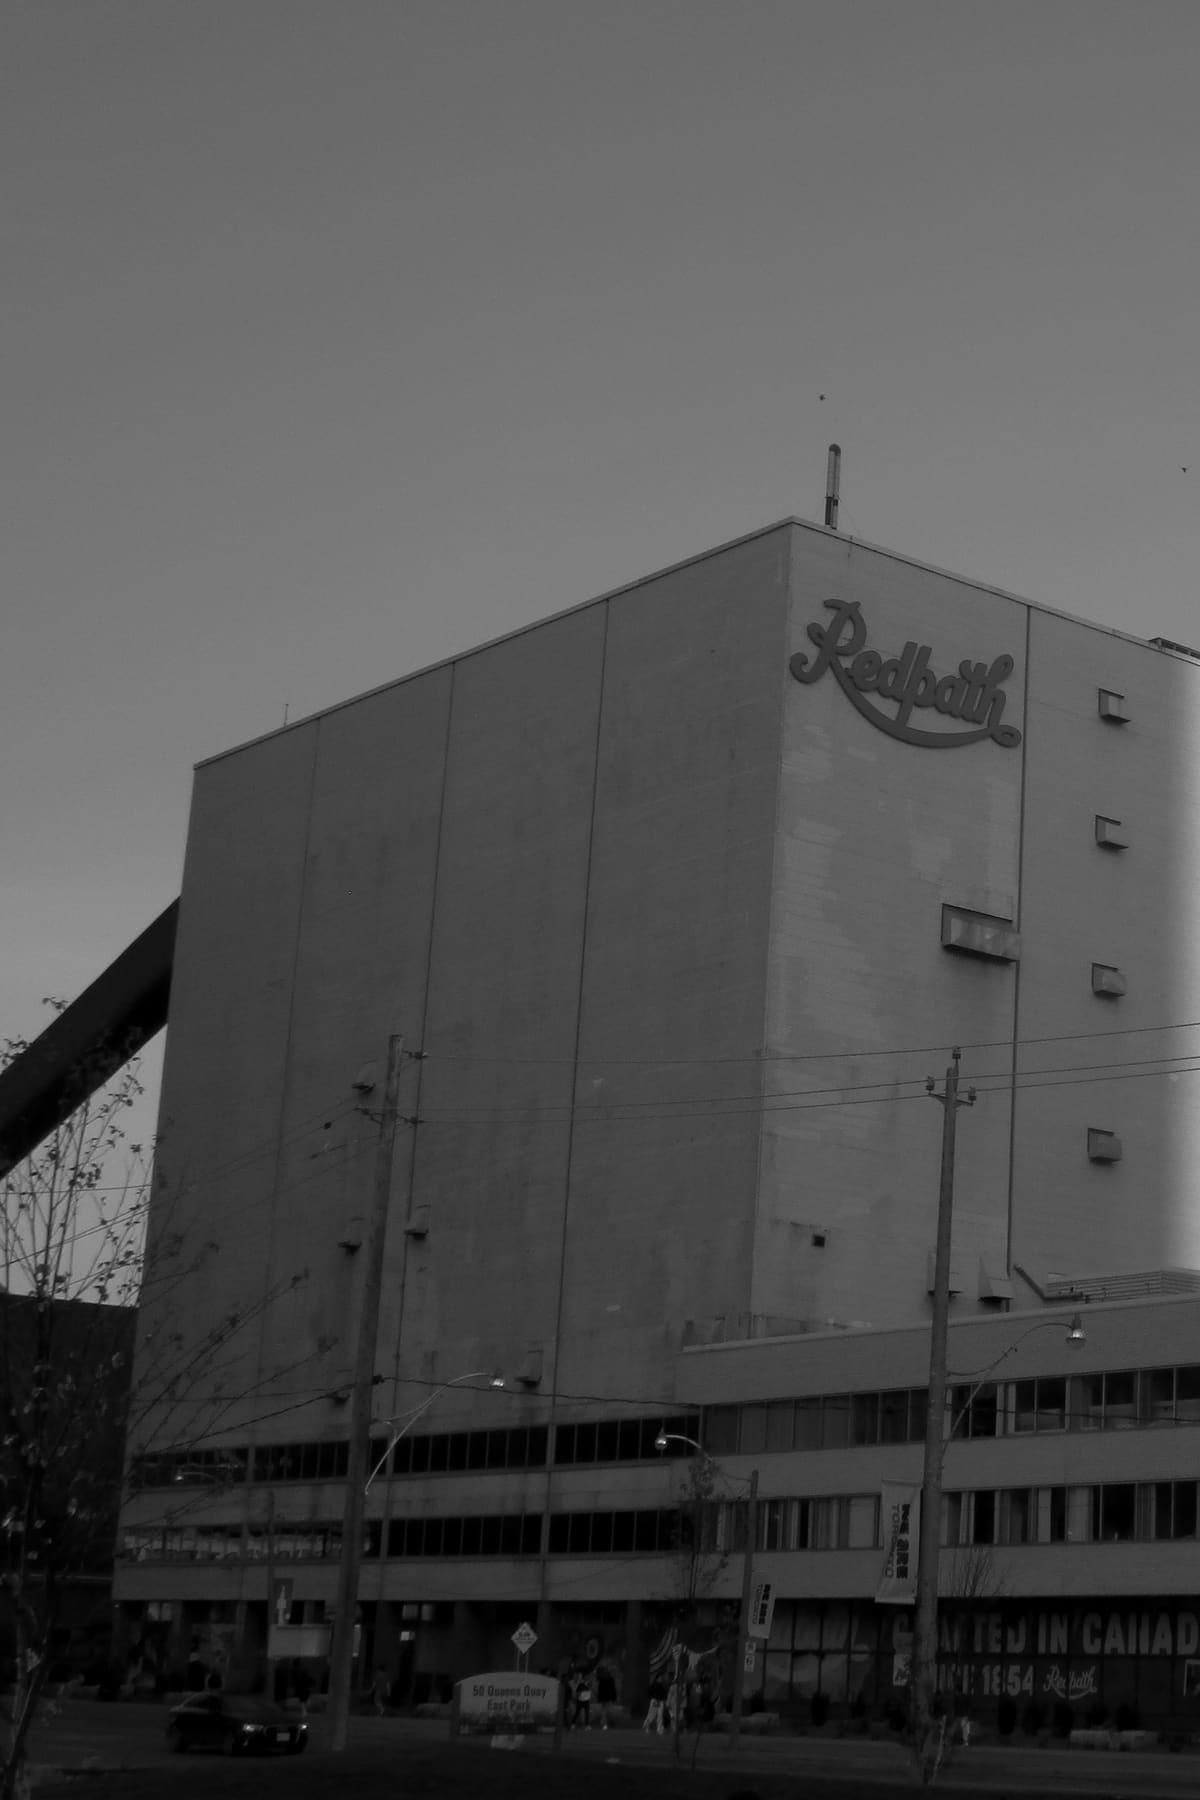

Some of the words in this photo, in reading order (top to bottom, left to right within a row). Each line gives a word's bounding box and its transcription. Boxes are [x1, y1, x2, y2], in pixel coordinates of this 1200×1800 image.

[789, 598, 1022, 749] Redpath
[1037, 1611, 1068, 1655] IN
[982, 1664, 1034, 1697] 1854
